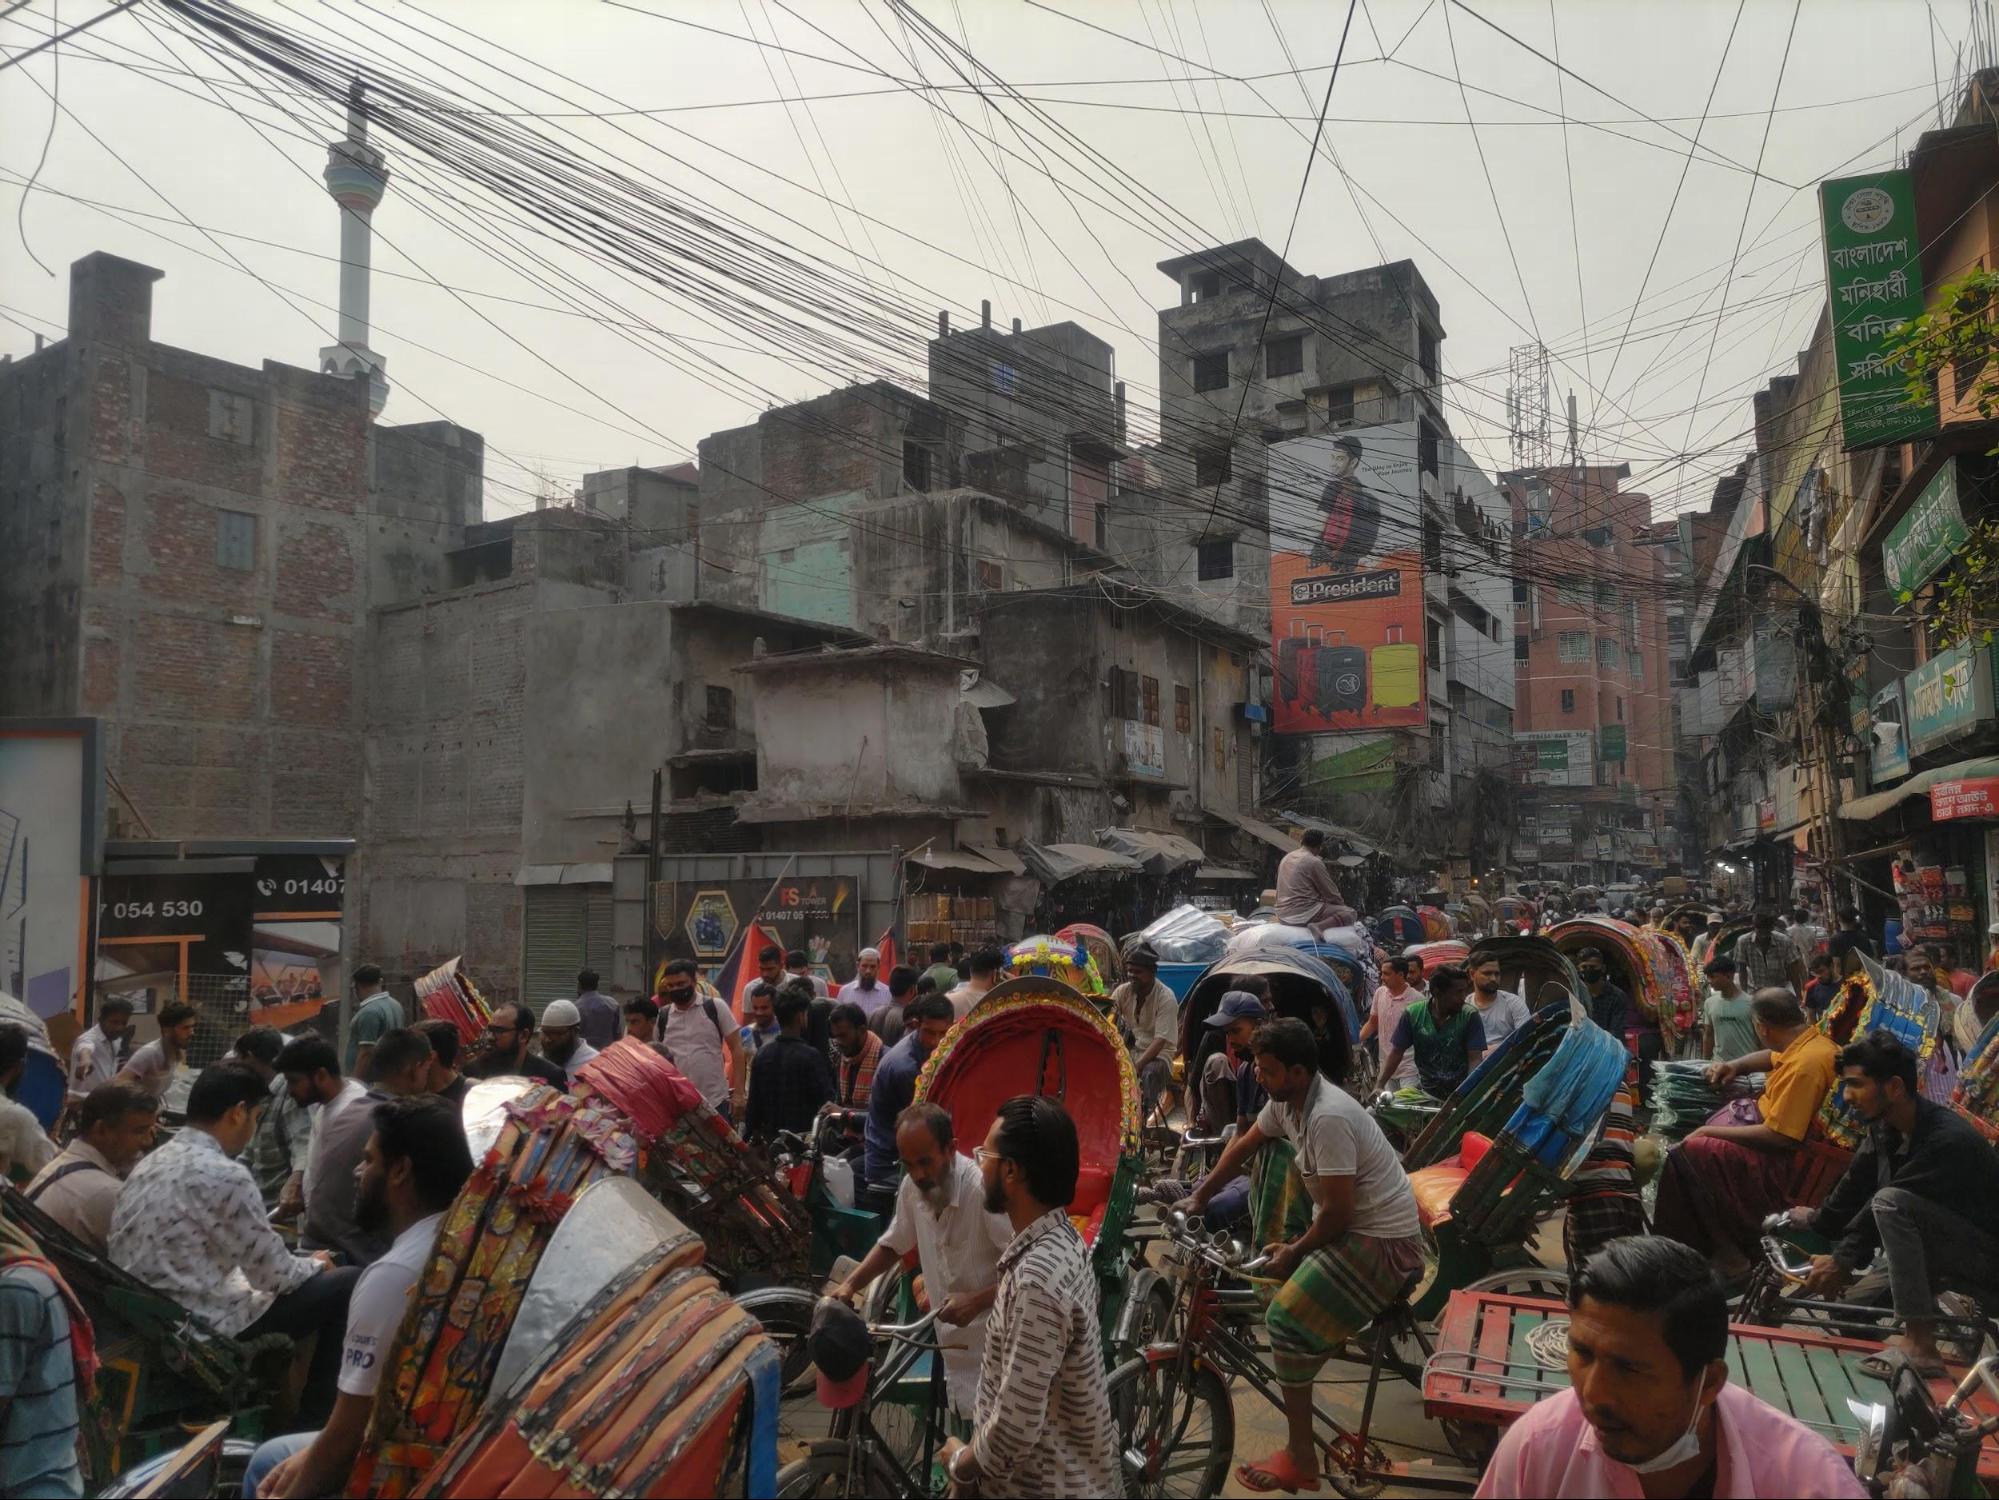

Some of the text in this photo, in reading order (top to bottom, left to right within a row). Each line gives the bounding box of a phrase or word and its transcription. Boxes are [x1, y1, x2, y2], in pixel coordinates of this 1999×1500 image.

[1832, 237, 1908, 269] বাংলাদেশ
[1838, 270, 1908, 305] মনিহারী
[1313, 576, 1396, 598] President
[1957, 791, 1988, 804] আউট
[113, 902, 155, 918] 054
[162, 900, 204, 917] 530
[346, 1347, 376, 1369] PRO
